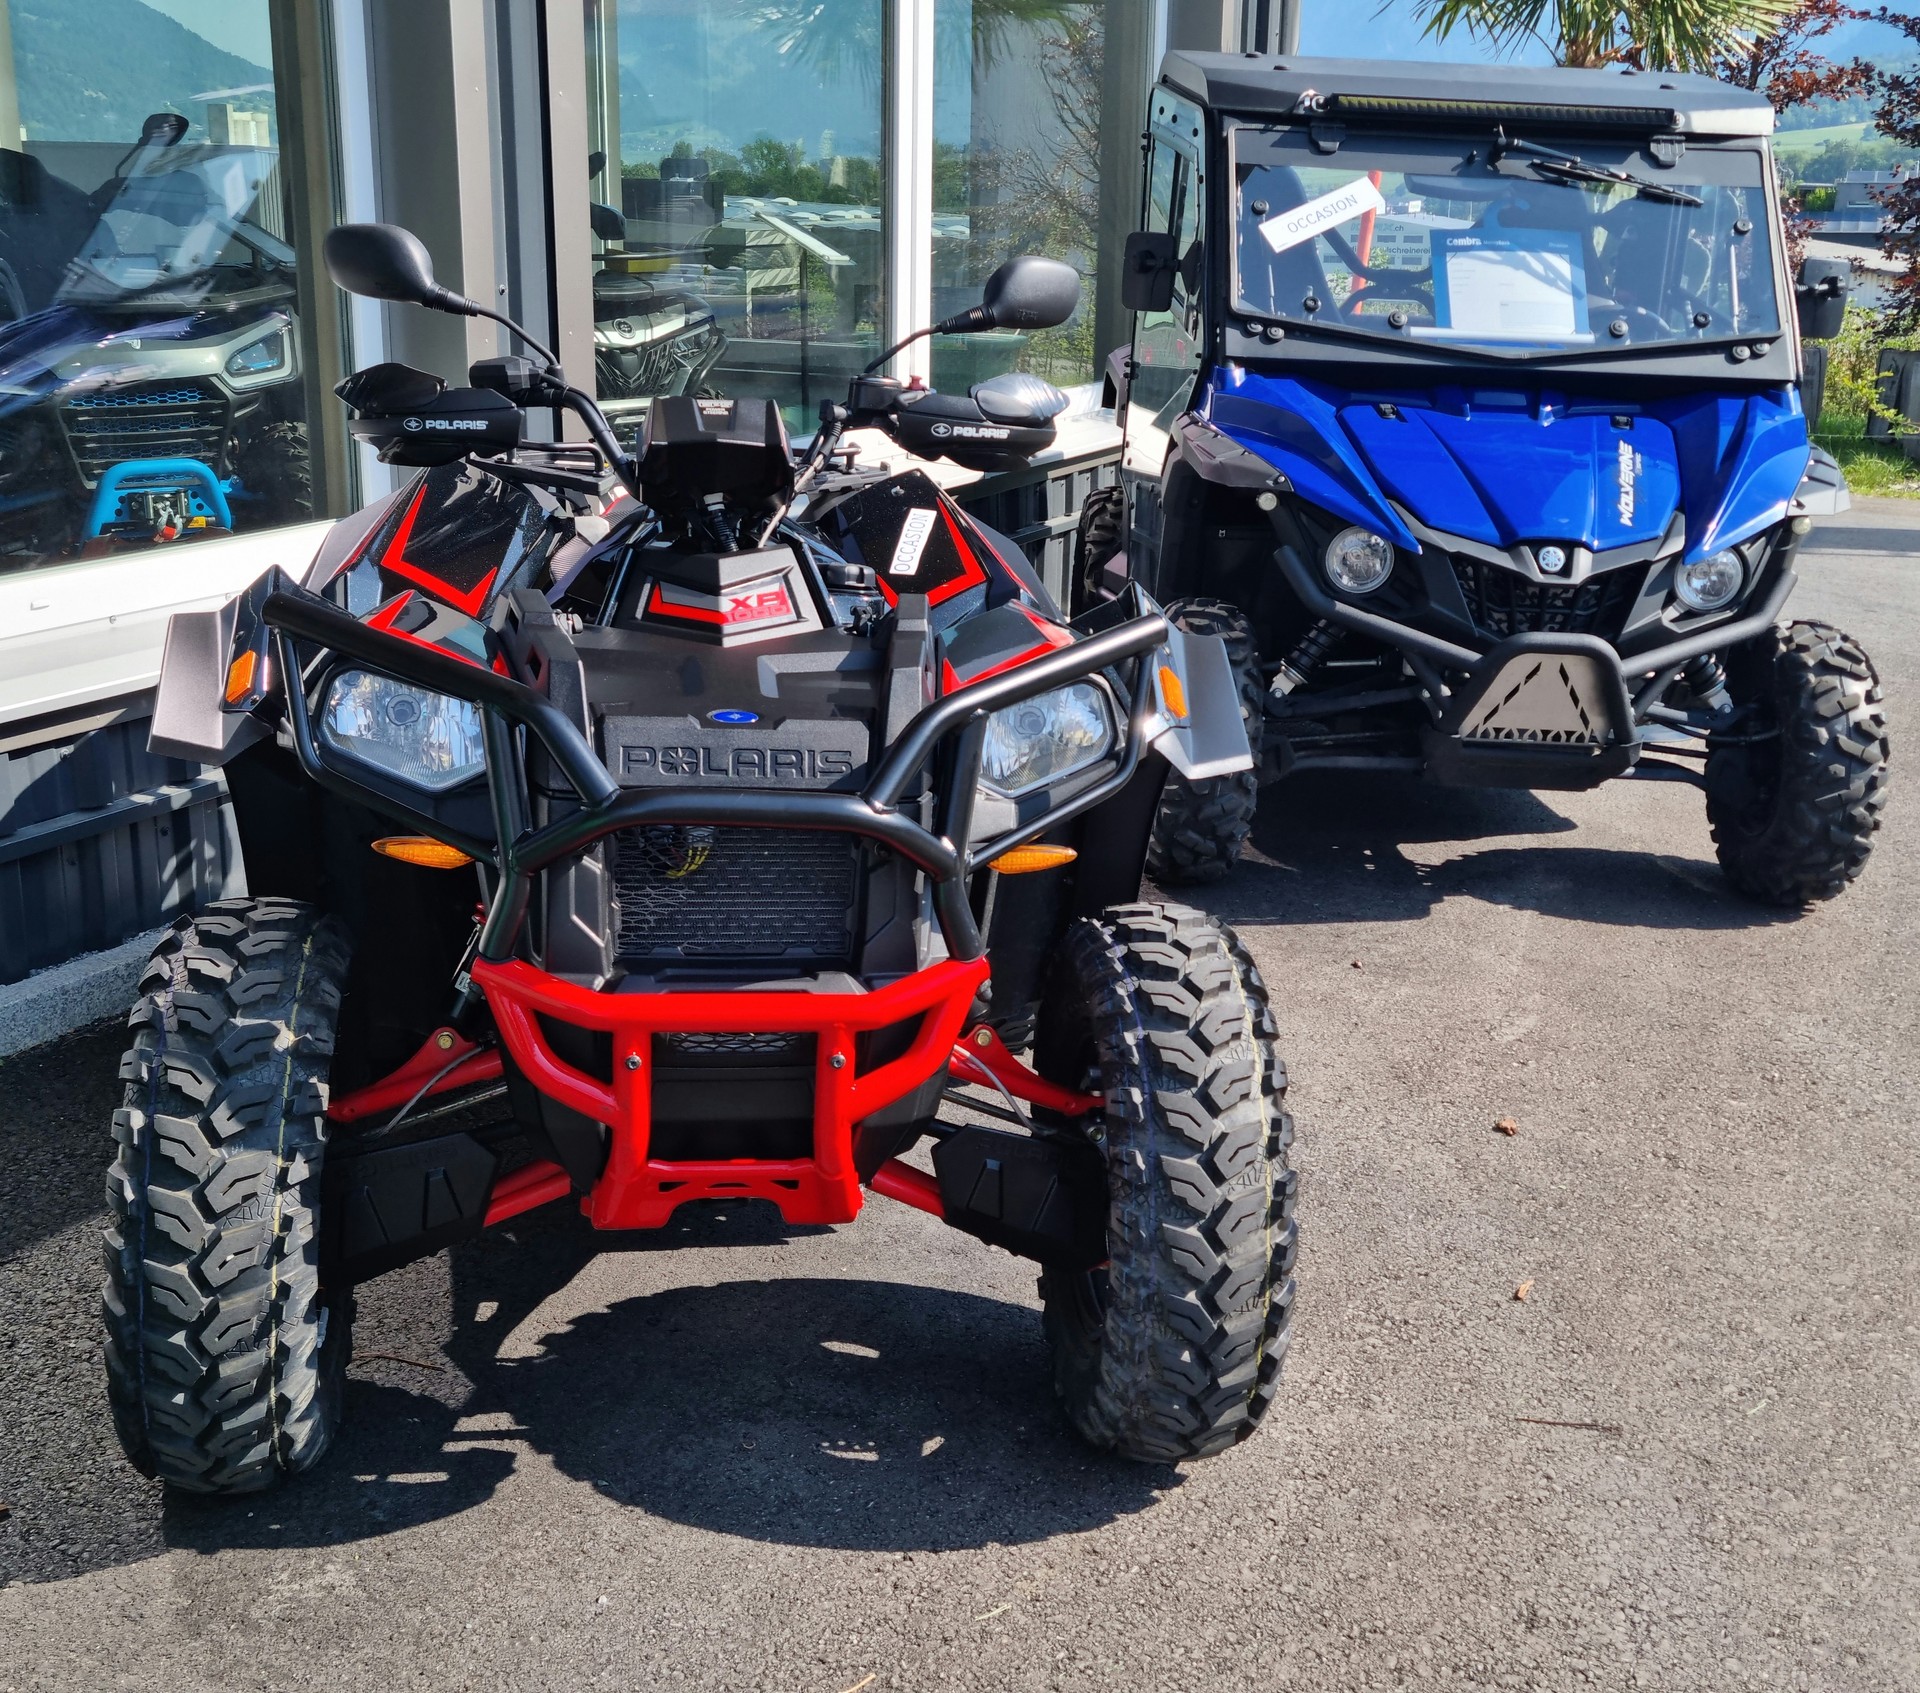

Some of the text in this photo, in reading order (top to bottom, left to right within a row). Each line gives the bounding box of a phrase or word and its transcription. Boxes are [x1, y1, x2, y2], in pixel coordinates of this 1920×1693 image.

[1287, 194, 1359, 234] OCCASION
[425, 420, 487, 430] POLARIS
[952, 427, 1009, 440] POLARIS
[1617, 439, 1635, 527] WOLVERINE
[894, 513, 928, 572] OCCASION
[728, 590, 785, 611] XP
[620, 745, 852, 779] POLARIS
